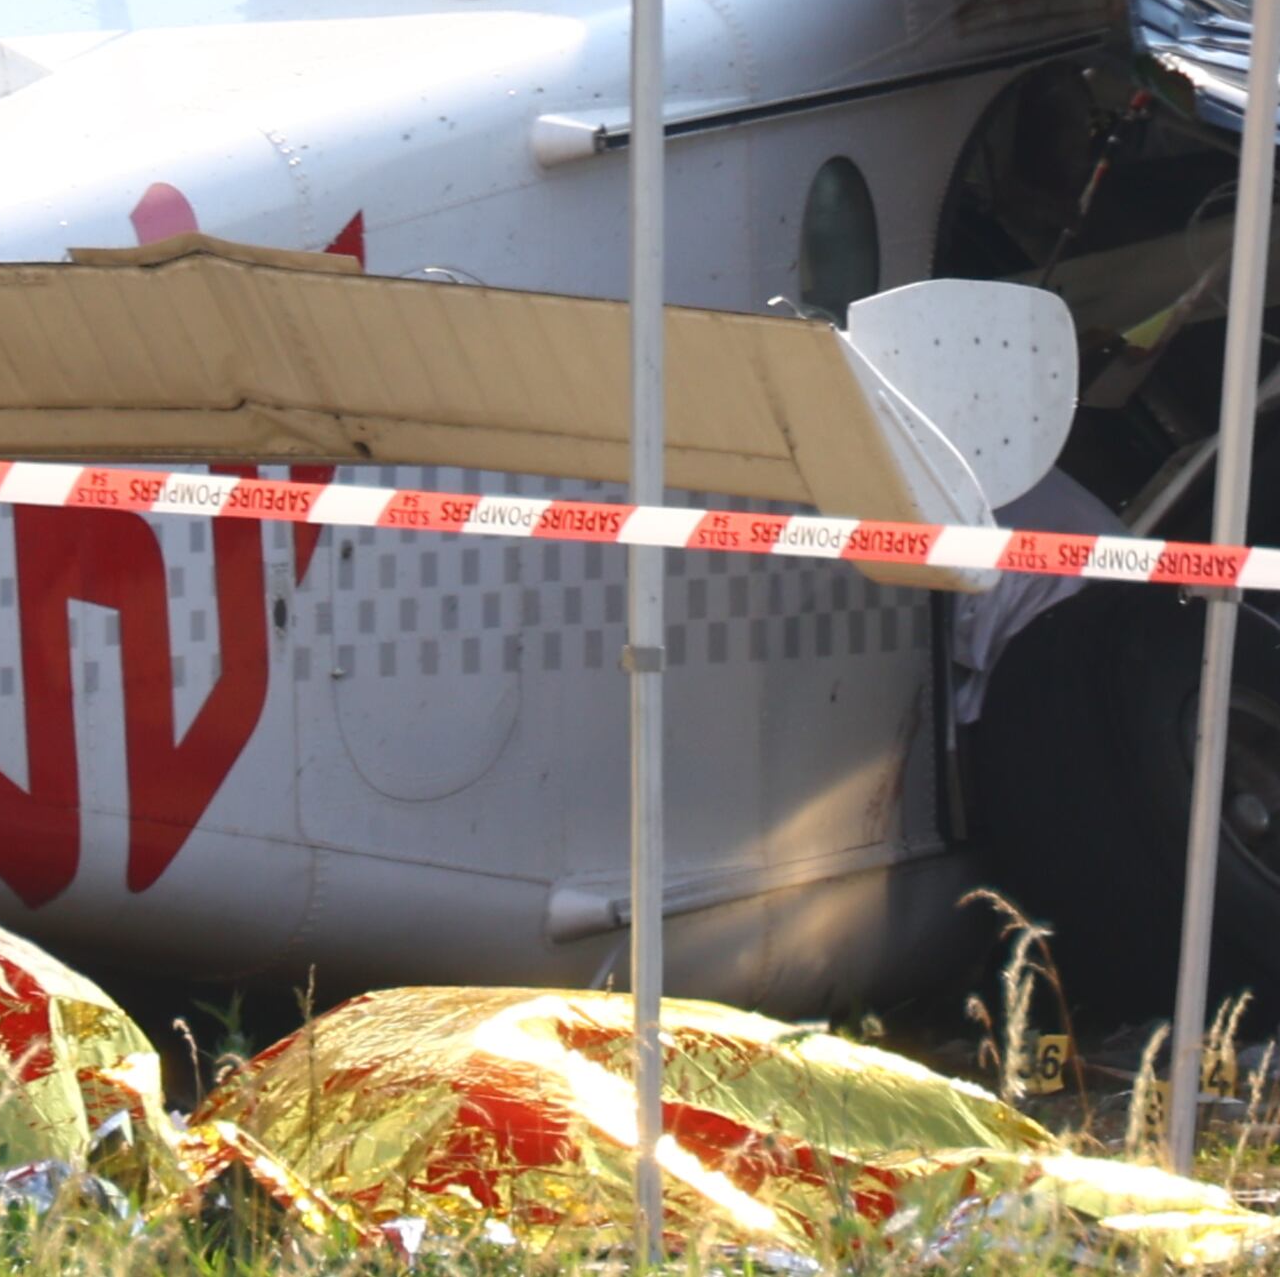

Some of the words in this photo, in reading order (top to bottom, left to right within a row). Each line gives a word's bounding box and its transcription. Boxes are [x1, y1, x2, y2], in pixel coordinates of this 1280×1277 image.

[129, 479, 310, 513] SAPEURS-POMPIERS
[440, 500, 620, 533] SAPEURS-POMPIERS
[750, 521, 928, 555] SAPEURS-POMPIERS
[1059, 543, 1238, 578] SAPEURS-POMPIERS
